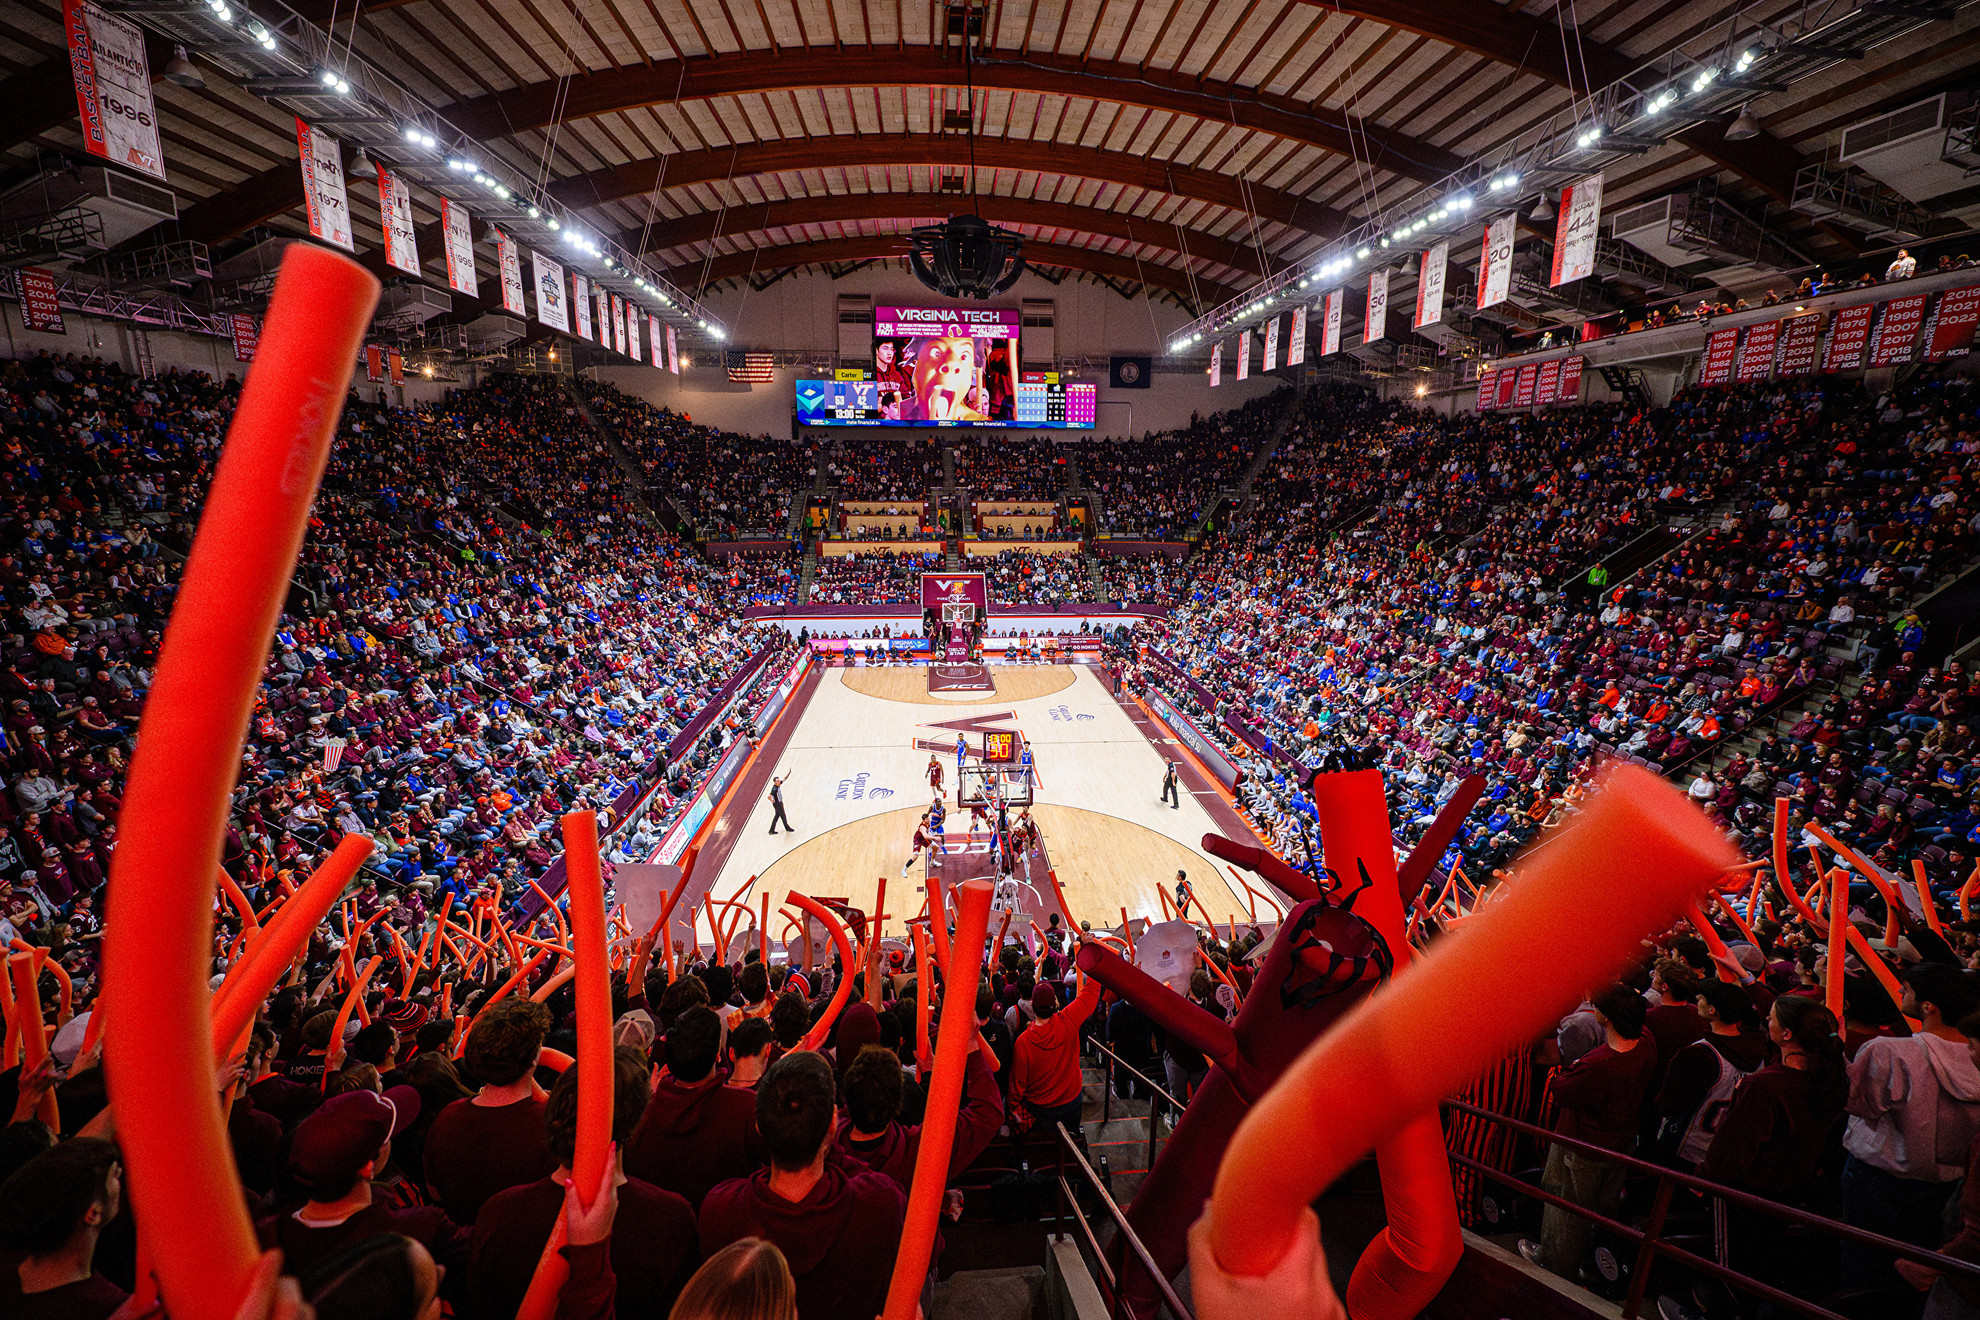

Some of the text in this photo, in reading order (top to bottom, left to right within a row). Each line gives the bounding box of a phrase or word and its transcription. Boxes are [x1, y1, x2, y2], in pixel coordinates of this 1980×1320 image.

[81, 4, 141, 40] CHAMPIONS
[72, 48, 86, 92] MEN'S
[72, 8, 103, 143] BASKETBALL
[100, 94, 152, 127] 1996
[137, 153, 156, 167] VT
[1568, 211, 1595, 233] 44
[451, 225, 470, 241] NIT
[1490, 245, 1511, 265] 20
[455, 254, 473, 268] 1995
[26, 278, 53, 290] 2013
[1428, 273, 1441, 287] 12
[14, 269, 31, 326] WRESTLING
[28, 289, 56, 301] 2014
[1945, 288, 1980, 301] 2019
[31, 300, 57, 311] 2017
[1371, 294, 1385, 309] 30
[1891, 298, 1922, 310] 1986
[1943, 300, 1979, 313] 2021
[33, 311, 61, 323] 2018
[896, 309, 1000, 322] VIRGINIA TECH
[1330, 312, 1339, 324] 12
[1841, 307, 1870, 318] 1967
[1888, 310, 1920, 322] 1996
[1792, 314, 1820, 325] 2010
[1839, 319, 1867, 329] 1976
[1939, 313, 1977, 325] 2022
[1752, 323, 1776, 333] 1984
[1793, 325, 1816, 335] 2011
[1884, 322, 1919, 334] 2007
[1924, 298, 1943, 356] BASKETBALL
[1924, 316, 1933, 340] MEN'S
[1714, 331, 1736, 340] 1966
[1750, 333, 1774, 343] 1995
[1836, 330, 1864, 340] 1979
[1870, 307, 1888, 363] BASKETBALL
[1883, 334, 1914, 345] 2017
[239, 338, 256, 347] 2017
[1713, 340, 1733, 349] 1973
[1789, 336, 1815, 346] 2016
[1822, 316, 1838, 369] BASKETBALL
[1833, 341, 1863, 351] 1980
[1711, 350, 1732, 359] 1977
[1747, 344, 1774, 354] 2005
[1787, 346, 1814, 357] 2023
[1880, 346, 1912, 357] 2018
[1946, 348, 1970, 357] NCAA
[1744, 354, 1772, 363] 2008
[1785, 356, 1812, 367] 2024
[1831, 352, 1860, 362] 1985
[1891, 355, 1911, 363] NCAA
[1709, 360, 1730, 368] 1982
[1743, 363, 1770, 373] 2009
[1841, 361, 1860, 369] NCAA
[1707, 369, 1729, 378] 1983
[852, 384, 874, 395] VT
[857, 396, 867, 405] 42
[835, 409, 854, 419] 13:00
[1169, 714, 1198, 748] Make financial
[988, 734, 1011, 742] 13:00
[990, 744, 1008, 758] 30
[835, 780, 853, 800] CLINIC
[852, 773, 870, 800] CARILION
[291, 1065, 325, 1075] HOKIE
